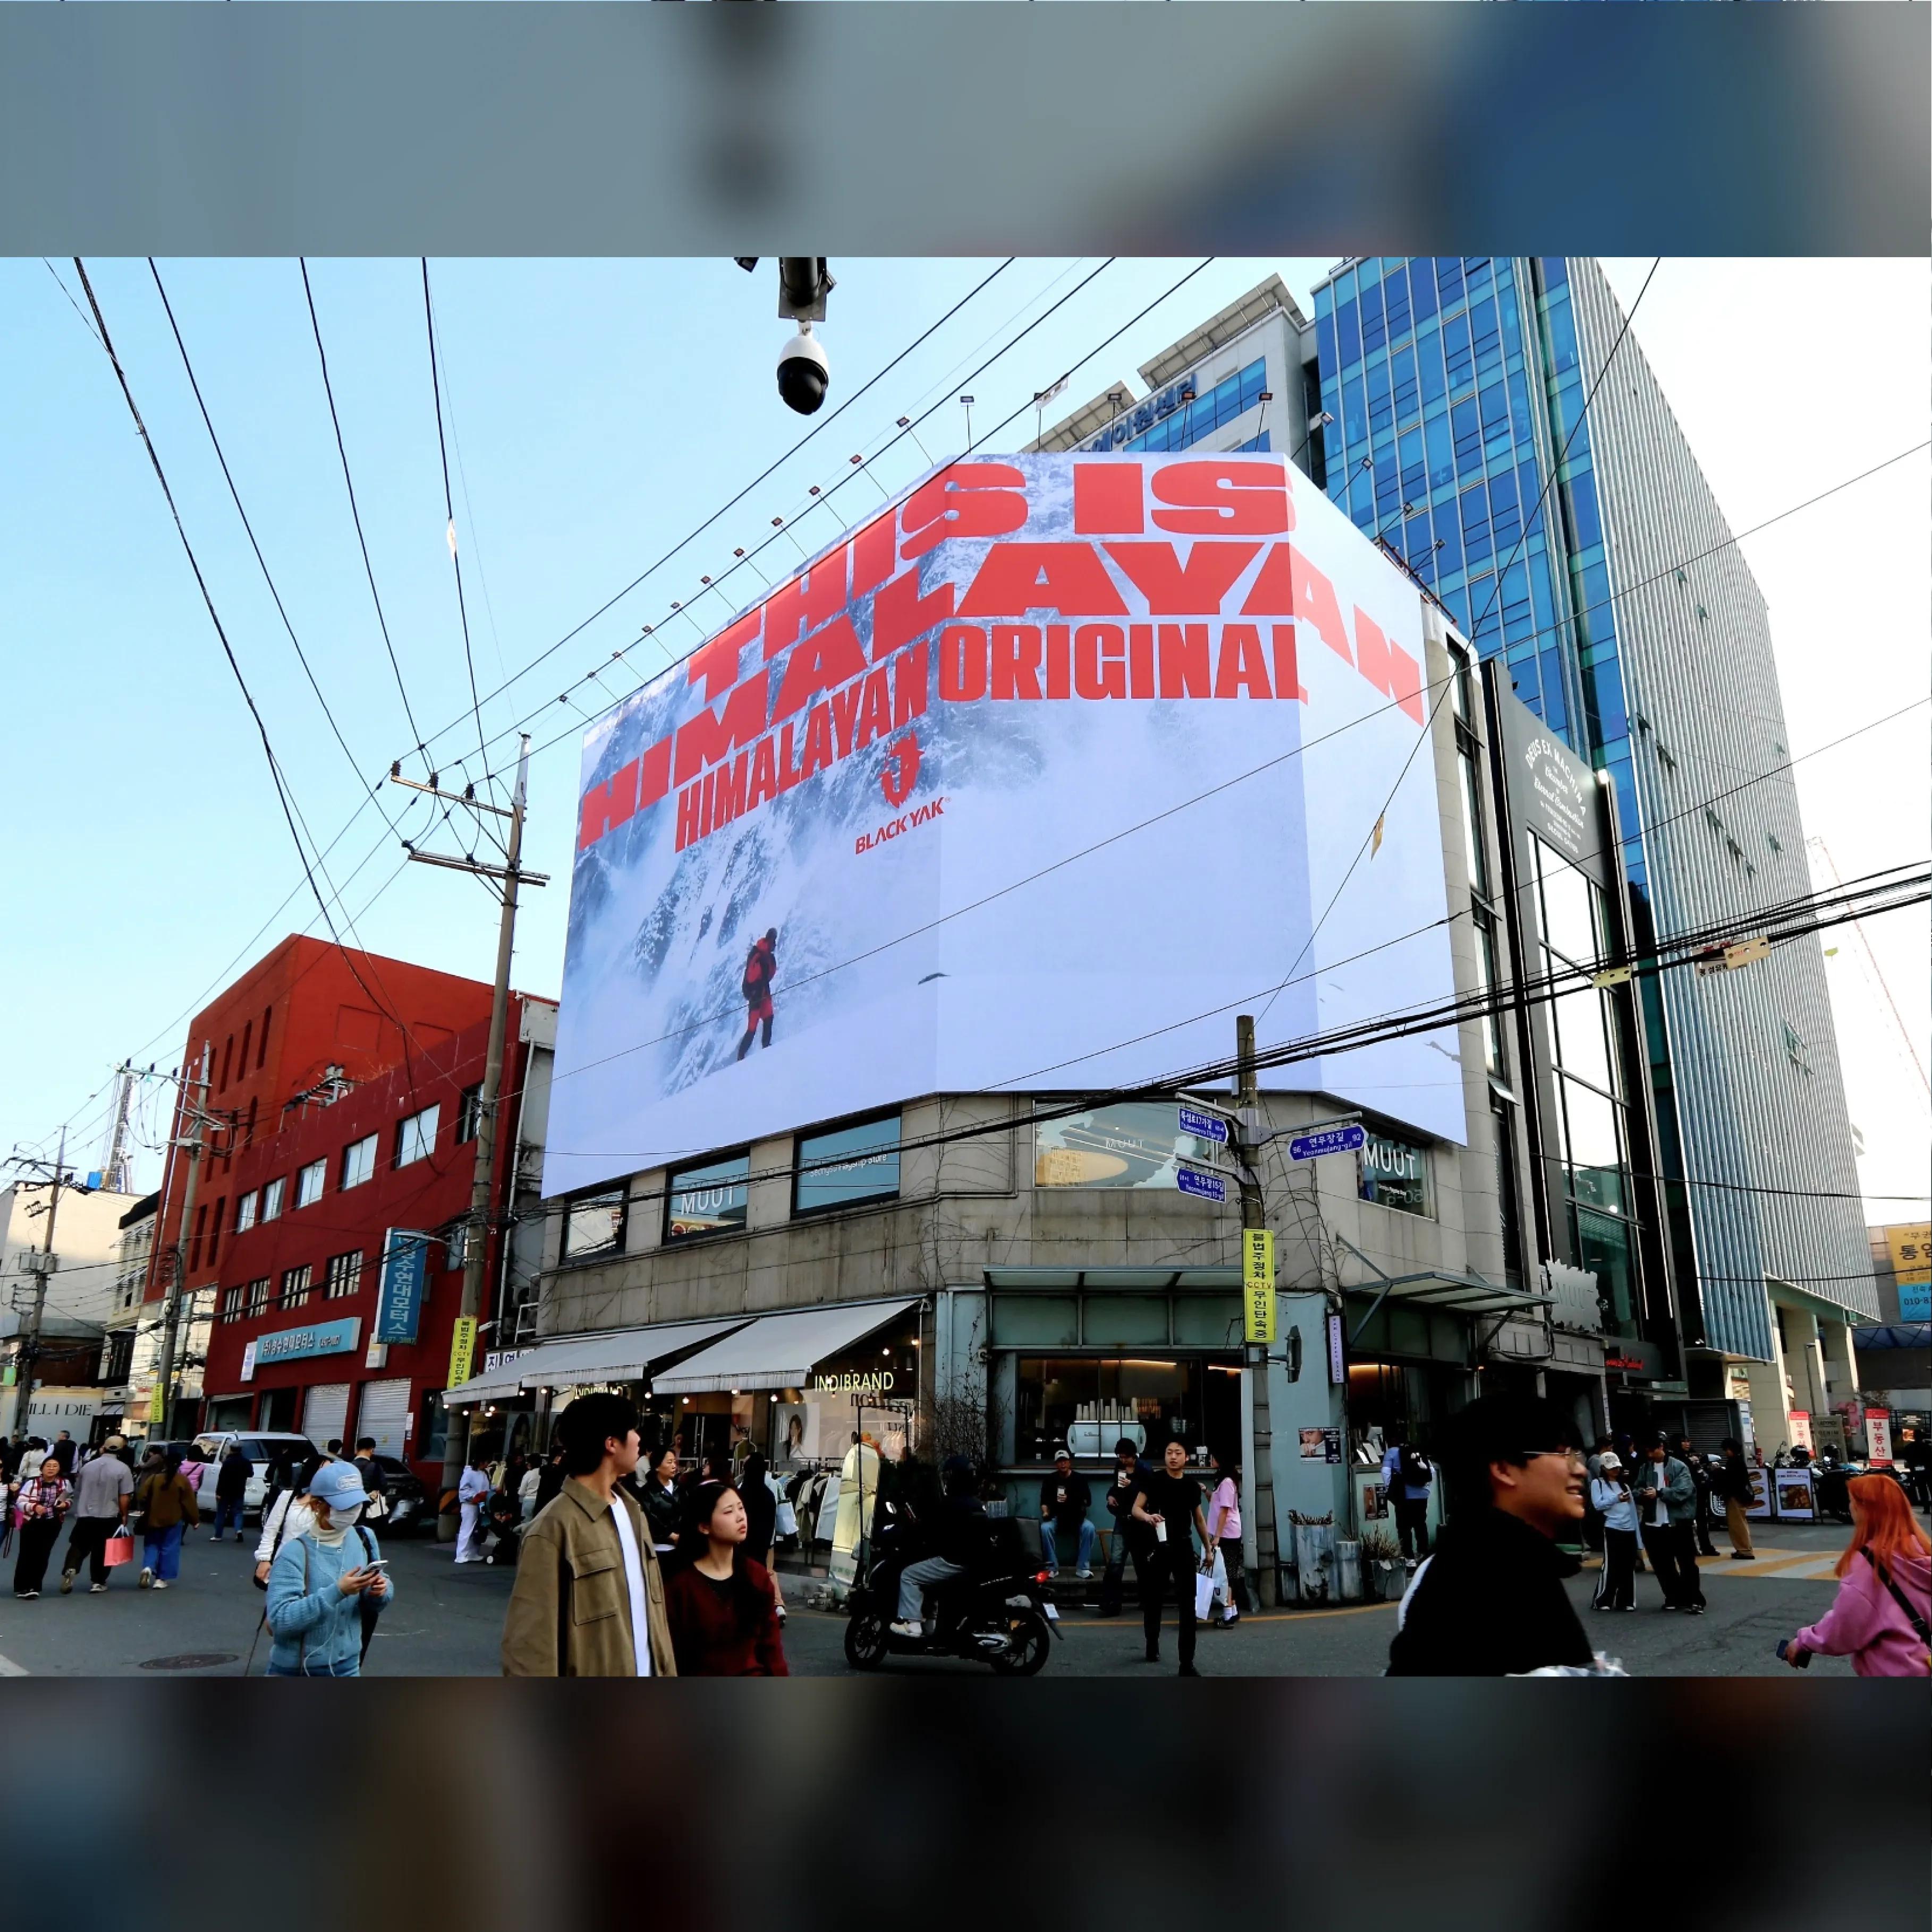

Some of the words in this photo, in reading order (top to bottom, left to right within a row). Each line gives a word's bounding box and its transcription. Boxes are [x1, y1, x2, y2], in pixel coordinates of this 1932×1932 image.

[689, 463, 1028, 704] THIS
[1074, 461, 1297, 535] IS
[580, 541, 1424, 850] HIMALAYAN
[675, 638, 928, 853] HIMALAYAN
[938, 624, 1308, 706] ORIGINAL
[1363, 1142, 1416, 1180] MUUT
[1254, 1291, 1267, 1338] 무인단속중
[815, 1371, 894, 1393] INDIBRAND
[65, 1404, 92, 1416] DIE
[1873, 1422, 1886, 1457] 부동산
